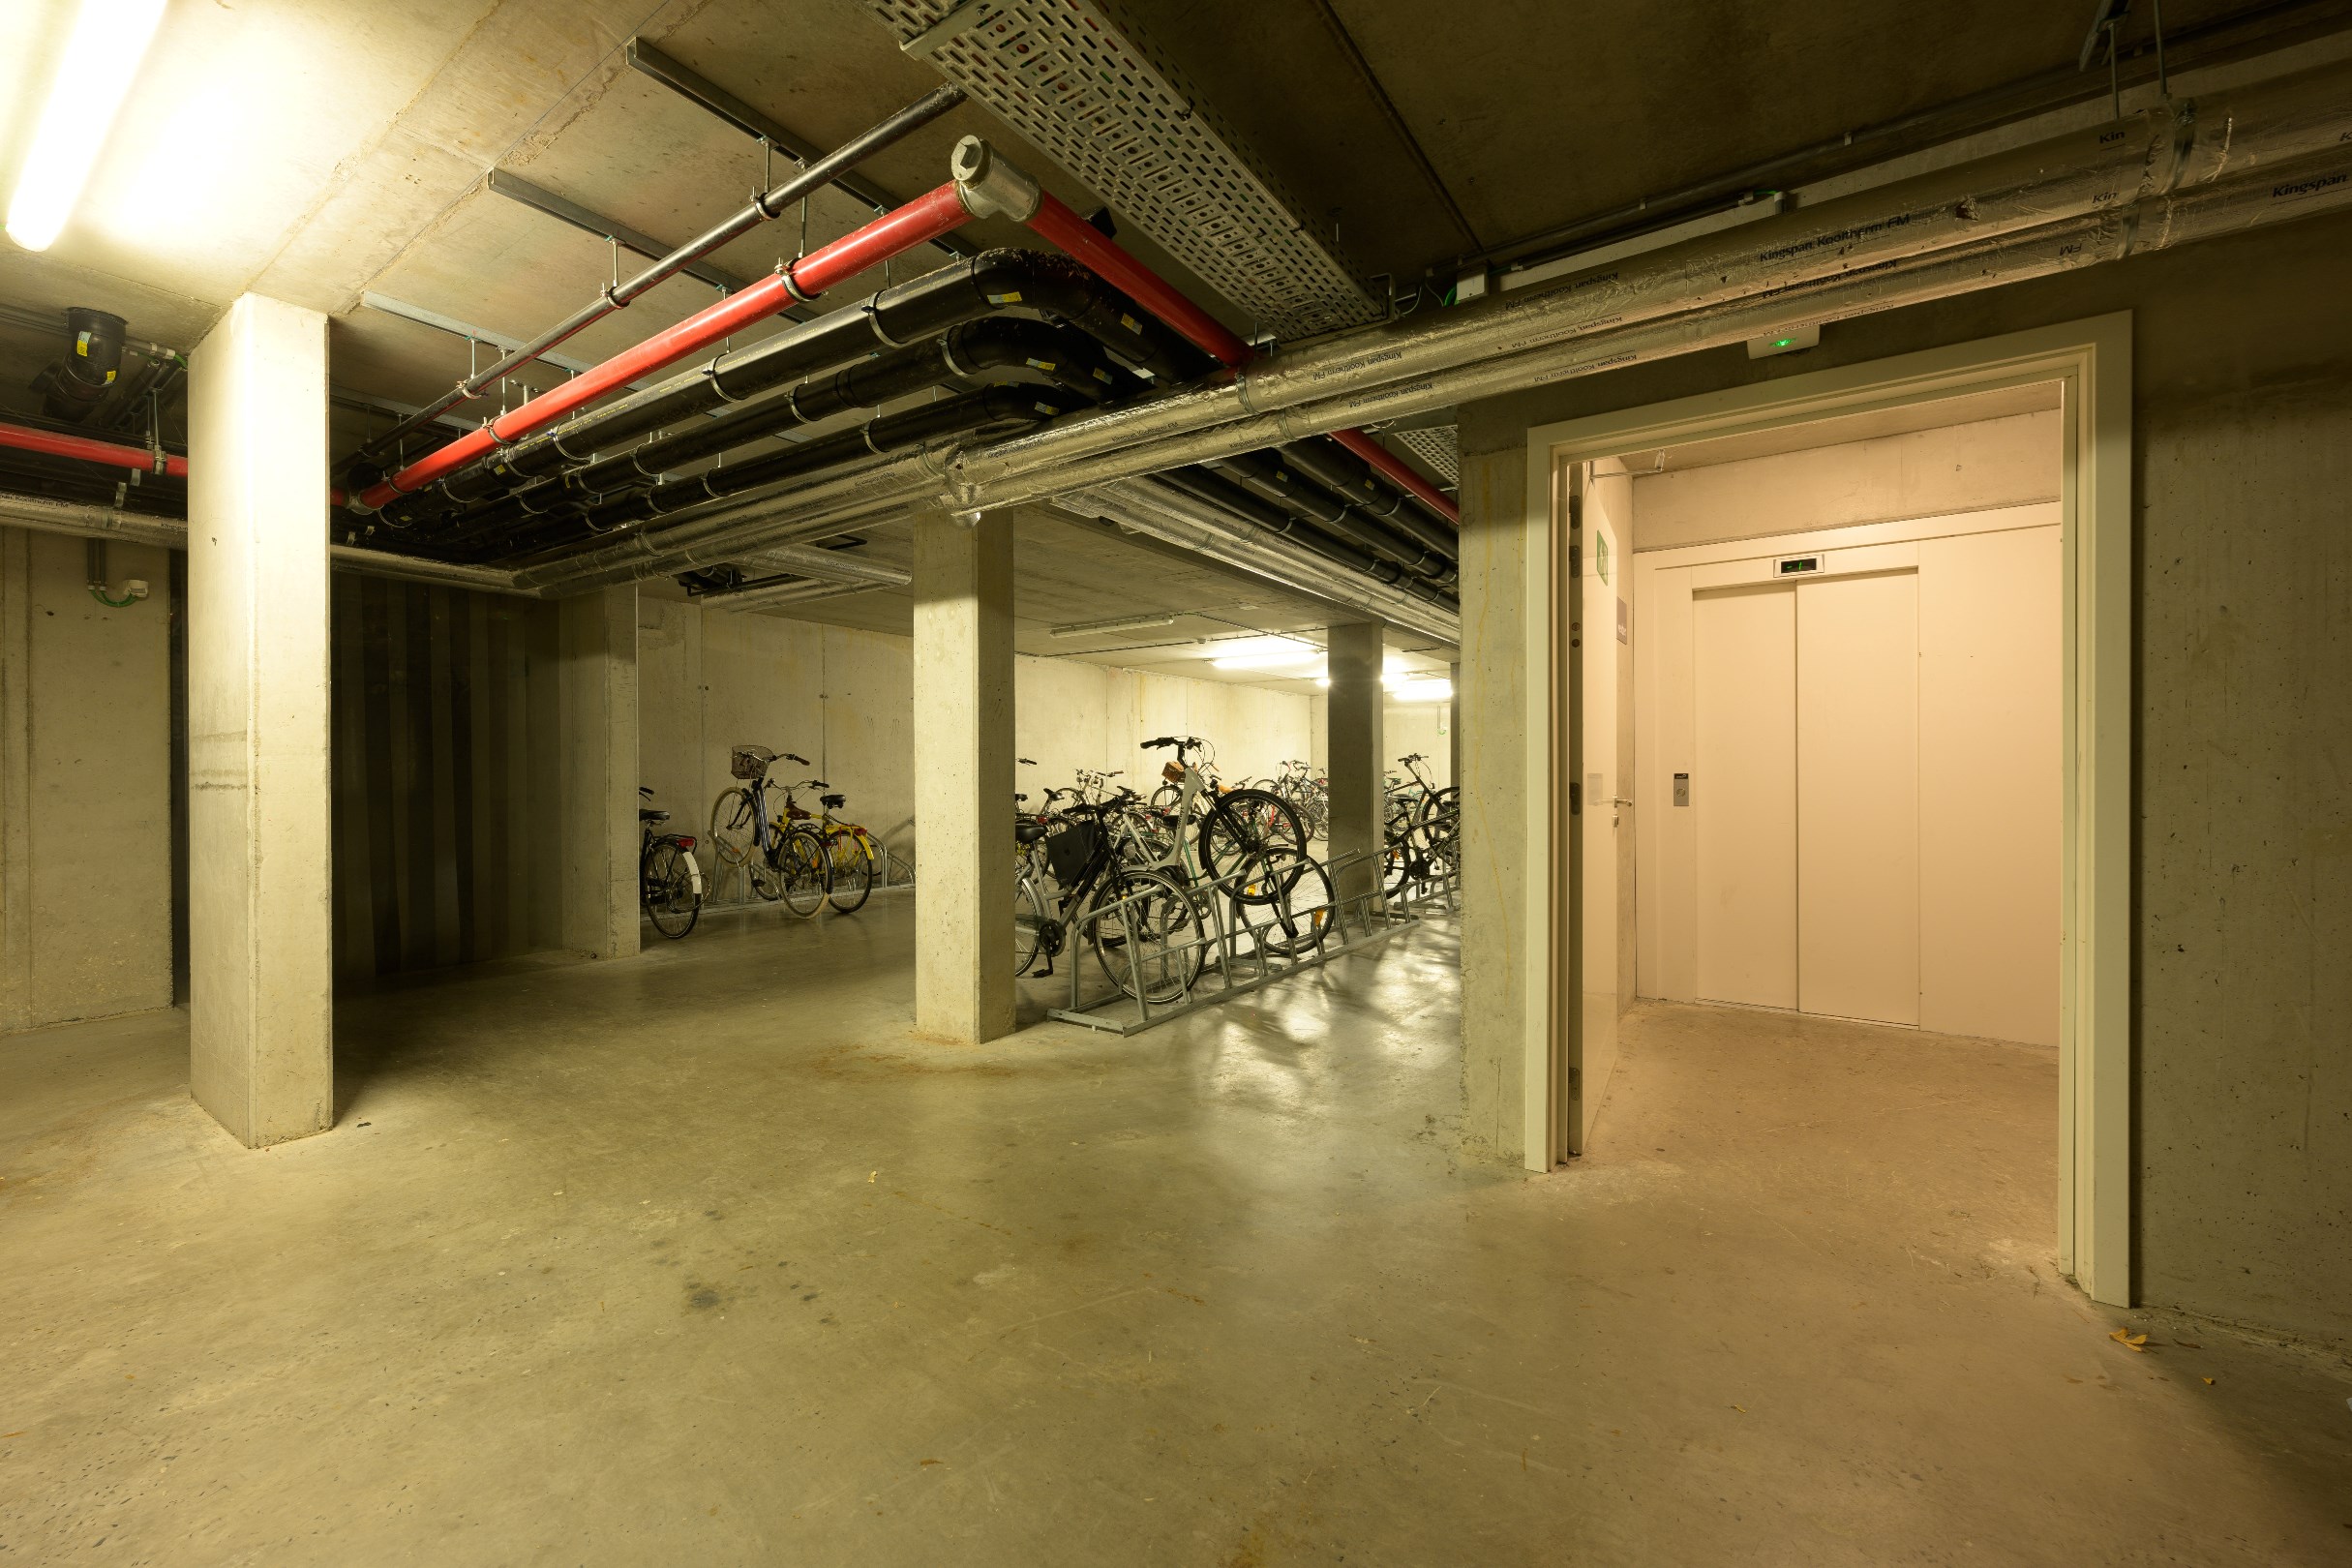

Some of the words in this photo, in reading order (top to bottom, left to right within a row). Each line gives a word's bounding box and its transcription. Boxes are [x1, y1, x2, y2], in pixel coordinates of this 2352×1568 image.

[2273, 172, 2347, 197] Kingspan
[1760, 242, 1812, 262] Kingspan
[1817, 224, 1882, 246] Kooltherm
[1887, 213, 1911, 228] FM
[1575, 272, 1618, 288] Kingspan
[1523, 286, 1572, 303] Kooltherm
[1505, 299, 1522, 311] FM
[1578, 317, 1622, 330] Kingspan
[1528, 328, 1577, 343] Kooltherm
[1367, 351, 1402, 365] Kingspan
[1597, 354, 1638, 367] Kingspan
[1312, 371, 1326, 381] FM
[1550, 364, 1595, 378] Kooltherm
